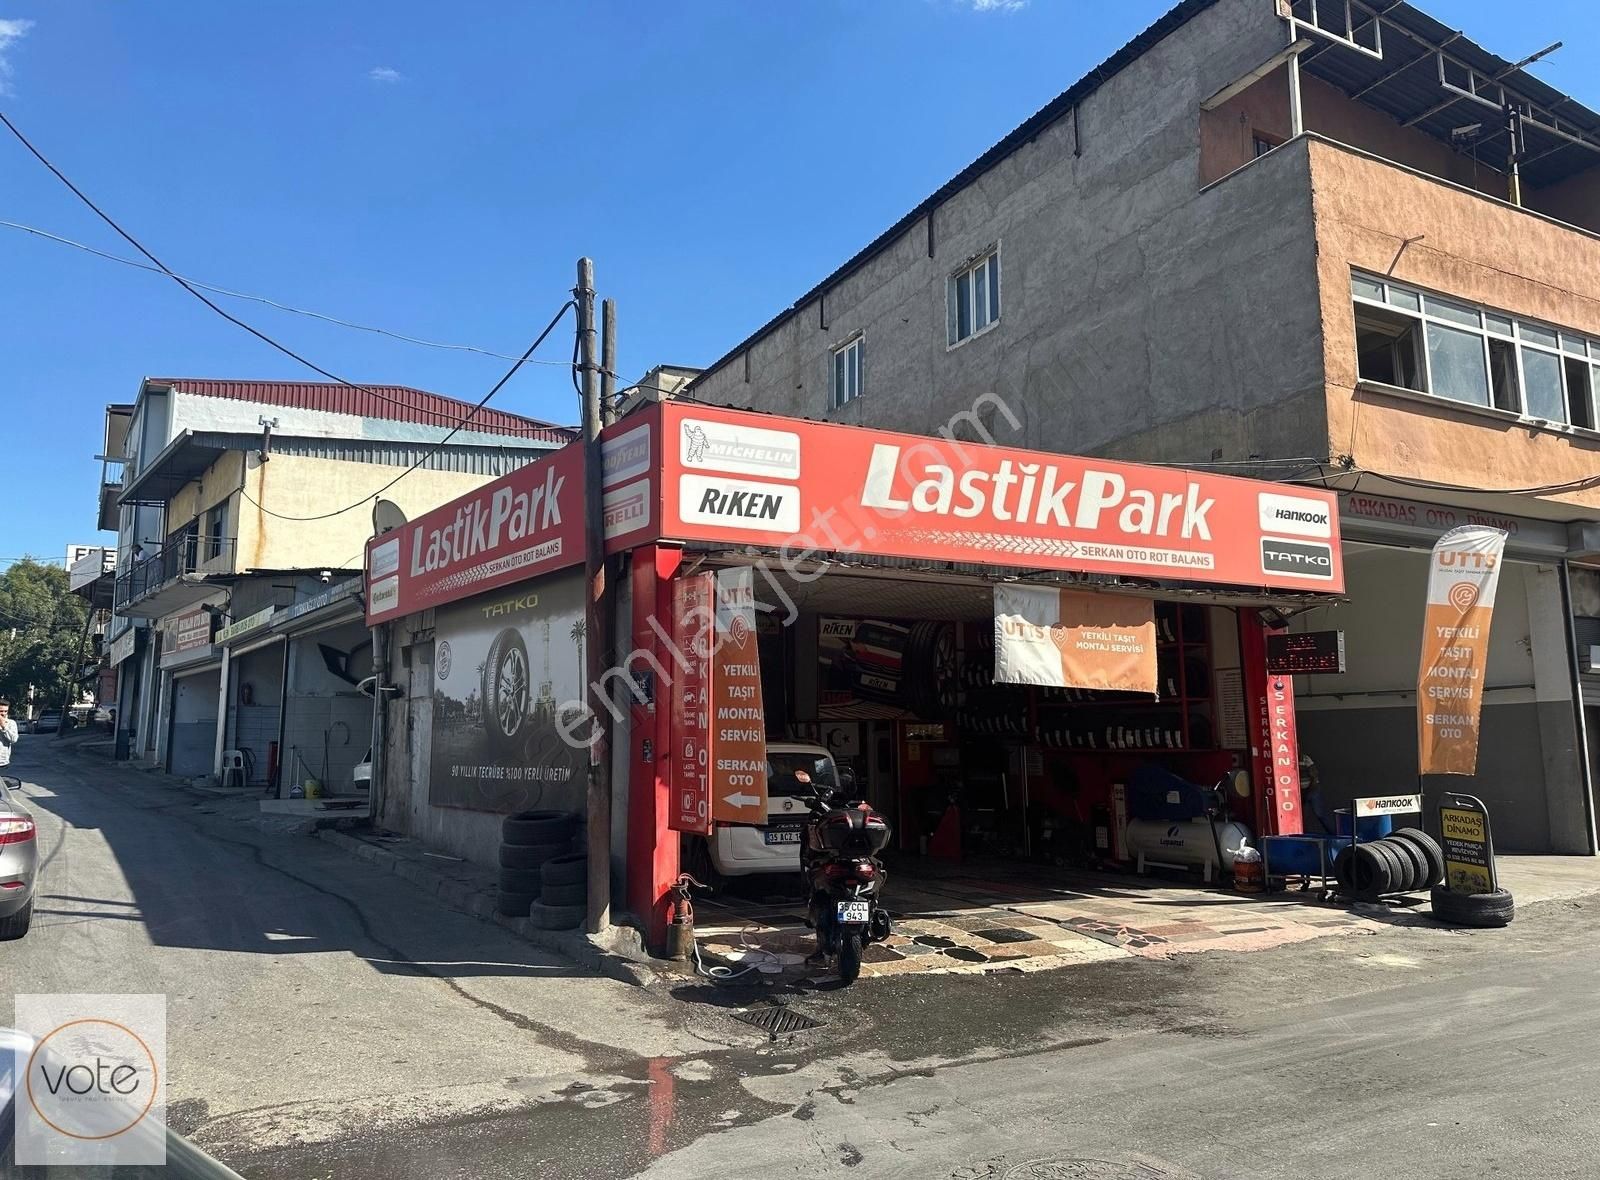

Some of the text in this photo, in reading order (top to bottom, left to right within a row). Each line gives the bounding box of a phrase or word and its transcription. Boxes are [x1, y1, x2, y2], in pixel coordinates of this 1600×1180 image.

[709, 443, 793, 464] MICHELIN
[603, 497, 644, 527] RELLI
[1349, 497, 1417, 526] ARKADAŞ
[1426, 508, 1456, 526] OTO
[489, 542, 560, 573] SERKAN OTO ROT BALANS
[1081, 545, 1210, 566] SERKAN OTO ROT BALANS
[1264, 550, 1330, 566] TATKO
[1439, 550, 1498, 569] UTTS
[720, 586, 752, 605] UTTS
[482, 594, 539, 618] TATKO
[1004, 621, 1045, 640] UTTS
[1076, 641, 1144, 653] MONTAJ SERVİSİ
[1113, 634, 1137, 644] TAŞIT
[1440, 646, 1472, 660] TAŞIT
[1427, 666, 1478, 679] MONTAJ
[728, 686, 756, 701] TAŞIT
[718, 708, 764, 720] MONTAJ
[1425, 713, 1474, 726] SERKAN
[720, 726, 762, 742] SERVİSİ
[1260, 696, 1271, 759] SERKAN
[1275, 691, 1291, 766] SERKAN
[1440, 727, 1463, 739] OTO
[451, 765, 459, 777] 90
[460, 765, 478, 777] YILLIK
[478, 764, 504, 779] TECRÜBE
[717, 759, 766, 773] SERKAN
[698, 748, 707, 818] OTO
[728, 774, 754, 786] OTO
[1265, 766, 1275, 796] OTO
[1280, 775, 1294, 811] OTO
[1443, 813, 1483, 828] ARKADAŞ
[1446, 824, 1480, 836] DİNAMO
[839, 902, 868, 911] 35 CCL
[846, 911, 863, 921] 943
